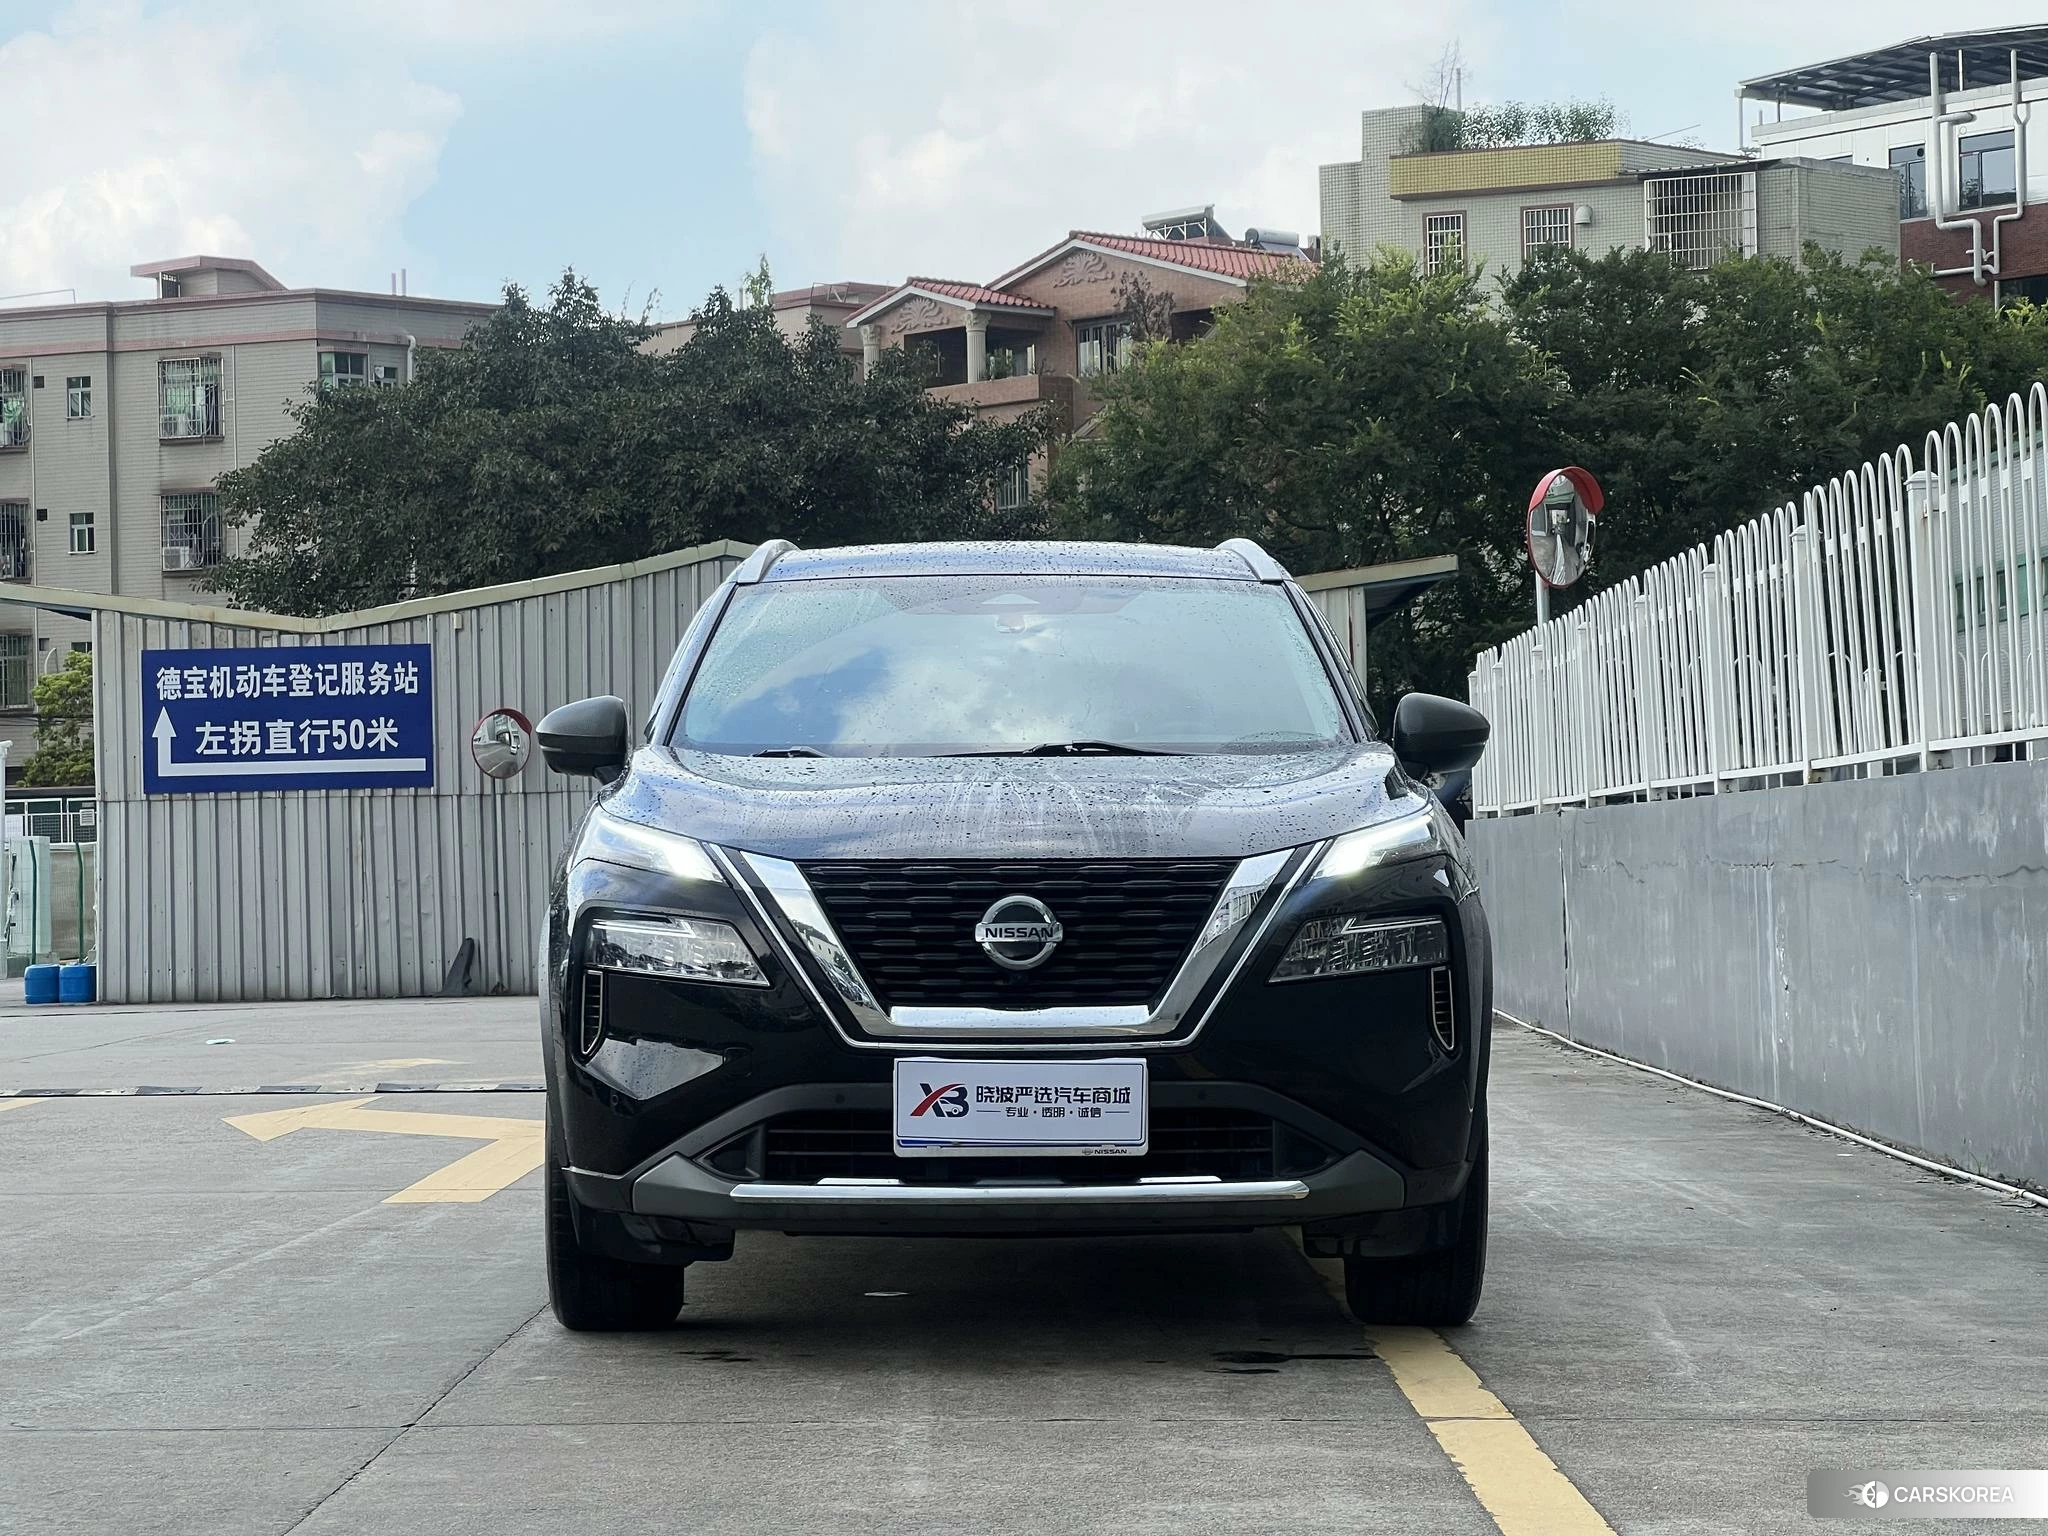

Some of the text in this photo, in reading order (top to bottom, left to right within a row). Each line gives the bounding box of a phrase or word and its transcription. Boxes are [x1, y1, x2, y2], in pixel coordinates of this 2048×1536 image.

[156, 661, 419, 700] 德宝机动车登记服务站
[195, 717, 399, 755] 左拐直行50米
[985, 927, 1053, 938] NISSAN
[976, 1086, 1131, 1104] 晓波严选汽车商城
